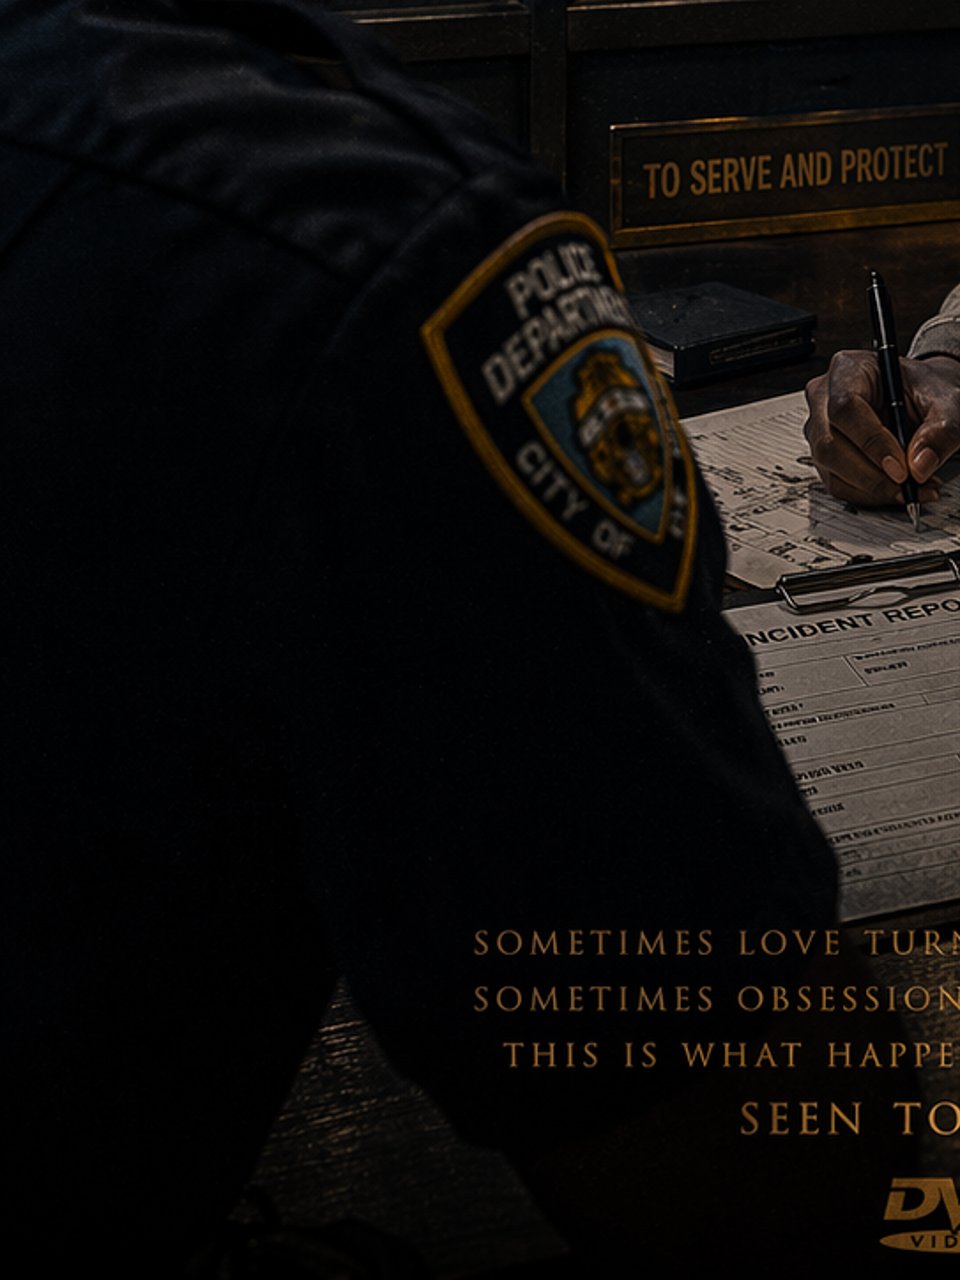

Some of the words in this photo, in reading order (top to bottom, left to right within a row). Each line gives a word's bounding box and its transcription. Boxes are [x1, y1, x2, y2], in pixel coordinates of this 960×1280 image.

[642, 160, 681, 201] TO
[689, 153, 774, 197] SERVE
[779, 150, 833, 190] AND
[840, 141, 950, 184] PROTECT
[513, 438, 591, 521] CITY
[589, 519, 637, 561] OF
